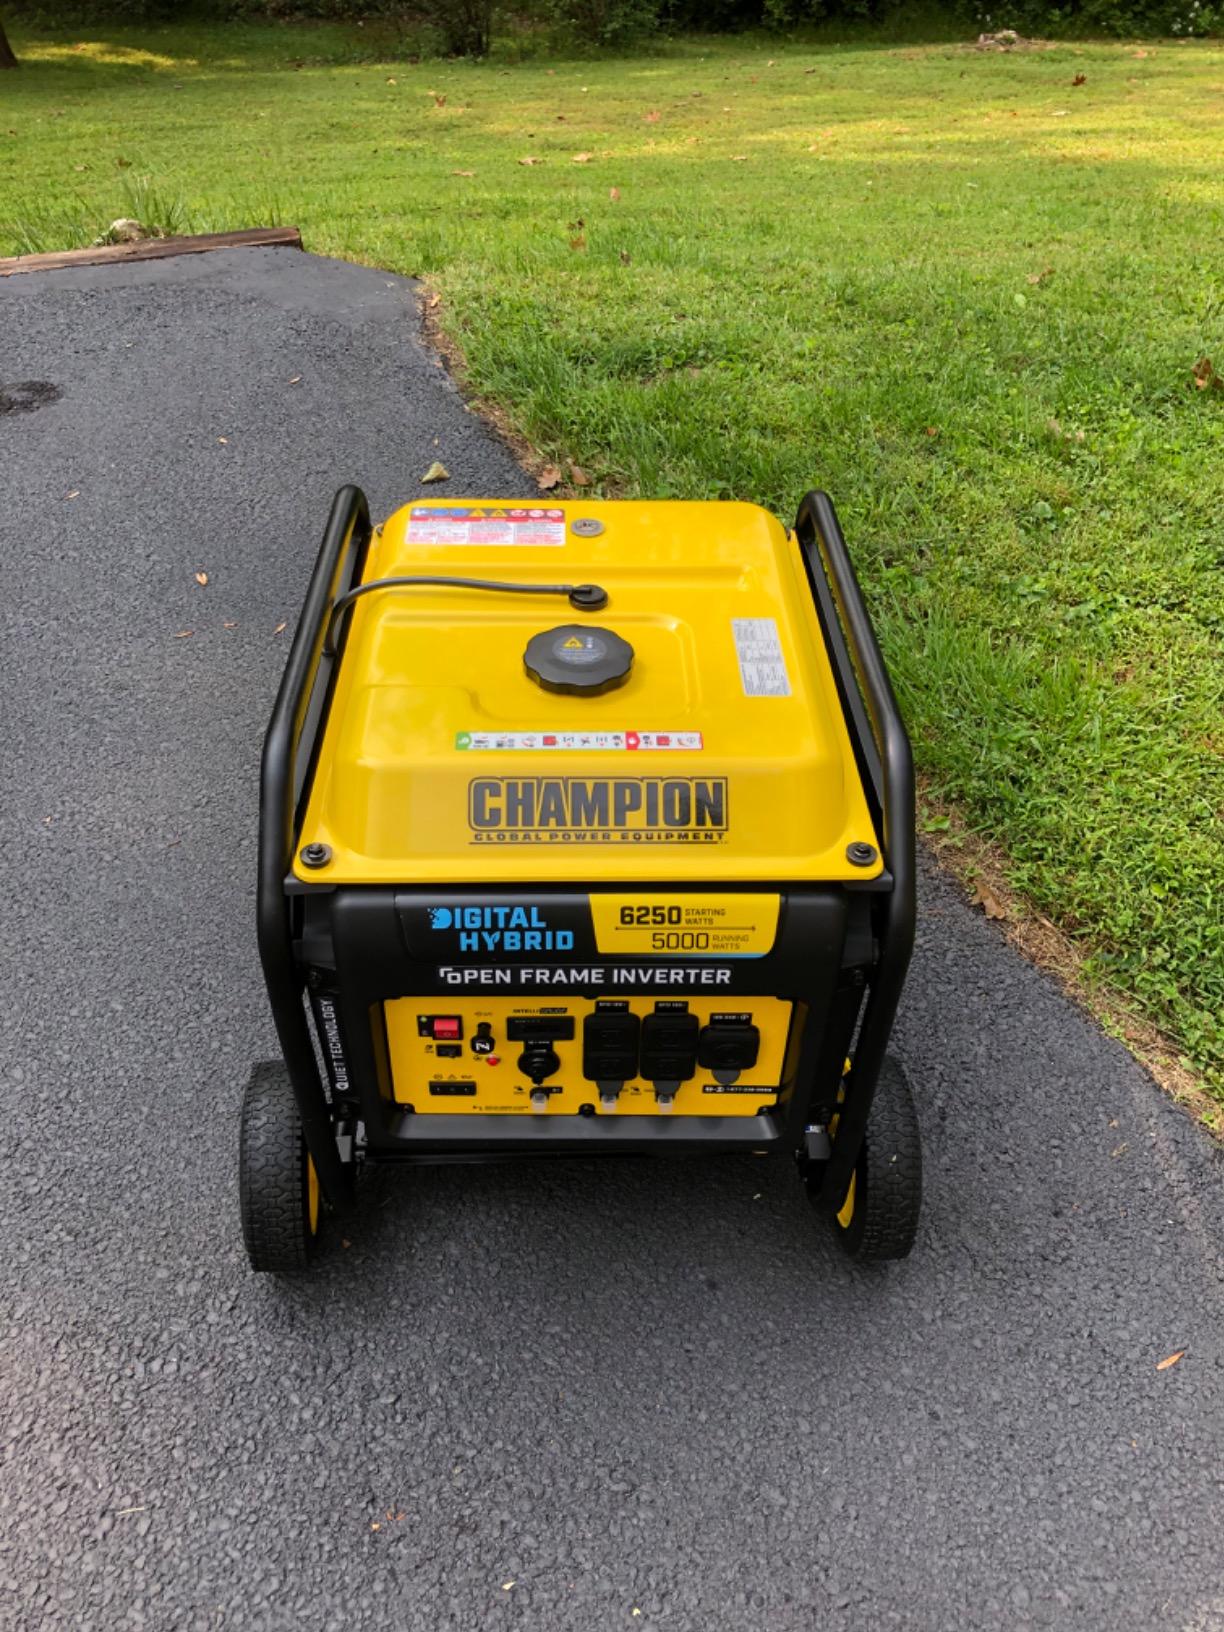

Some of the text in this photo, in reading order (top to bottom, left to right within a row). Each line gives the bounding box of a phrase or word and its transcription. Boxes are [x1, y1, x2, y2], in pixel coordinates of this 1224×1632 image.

[472, 780, 725, 829] CHAMPION
[474, 831, 725, 842] GLOBAL POWER EQUIPMENT
[428, 906, 547, 929] DIGITAL
[620, 905, 682, 926] 6250
[685, 908, 726, 917] STARTING
[685, 917, 714, 926] WATTS
[460, 930, 574, 952] HYBRID
[652, 932, 709, 950] 5000
[712, 934, 749, 942] RUNNING
[712, 942, 741, 950] WATTS
[439, 967, 731, 985] OPEN FRAME INVERTER
[320, 999, 349, 1091] QUIET TECHNOLOGY
